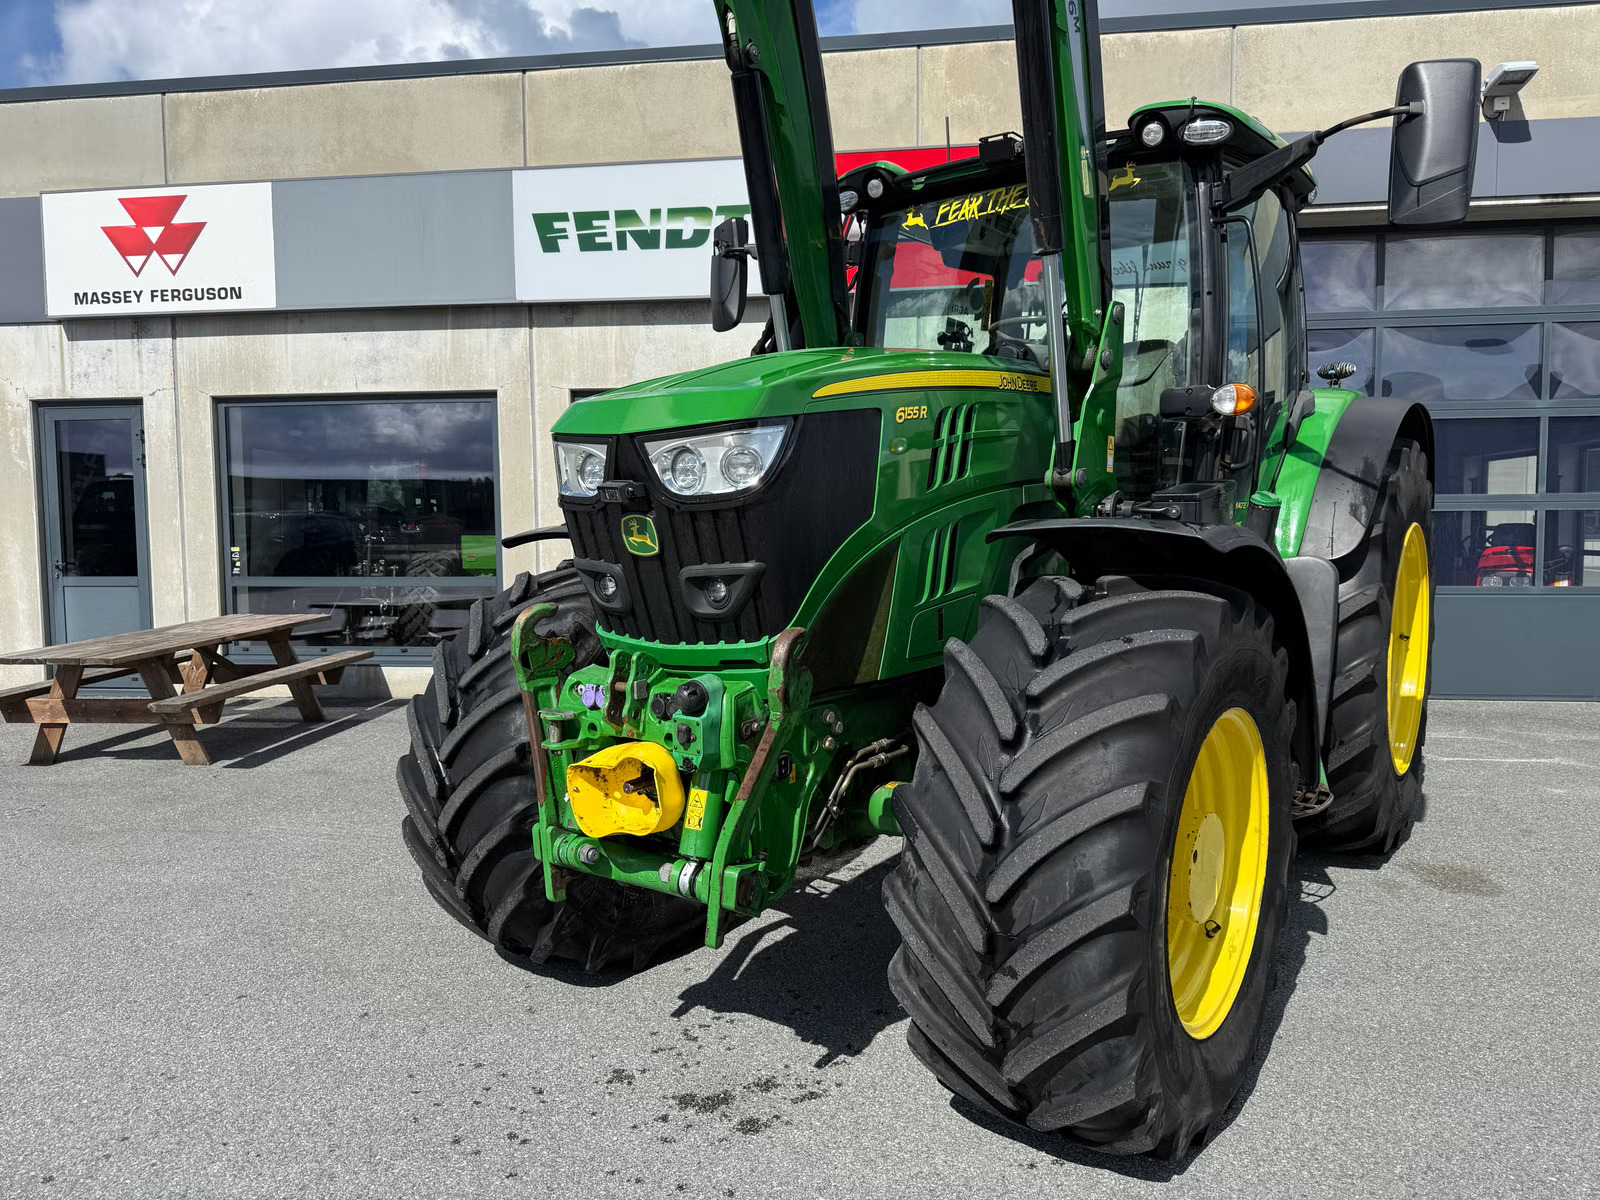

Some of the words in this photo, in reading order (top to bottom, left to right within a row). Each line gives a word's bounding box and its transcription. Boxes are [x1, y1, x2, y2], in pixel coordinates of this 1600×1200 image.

[935, 193, 984, 221] FEAR
[987, 185, 1028, 214] THE
[74, 290, 144, 306] MASSEY
[150, 286, 243, 303] FERGUSON
